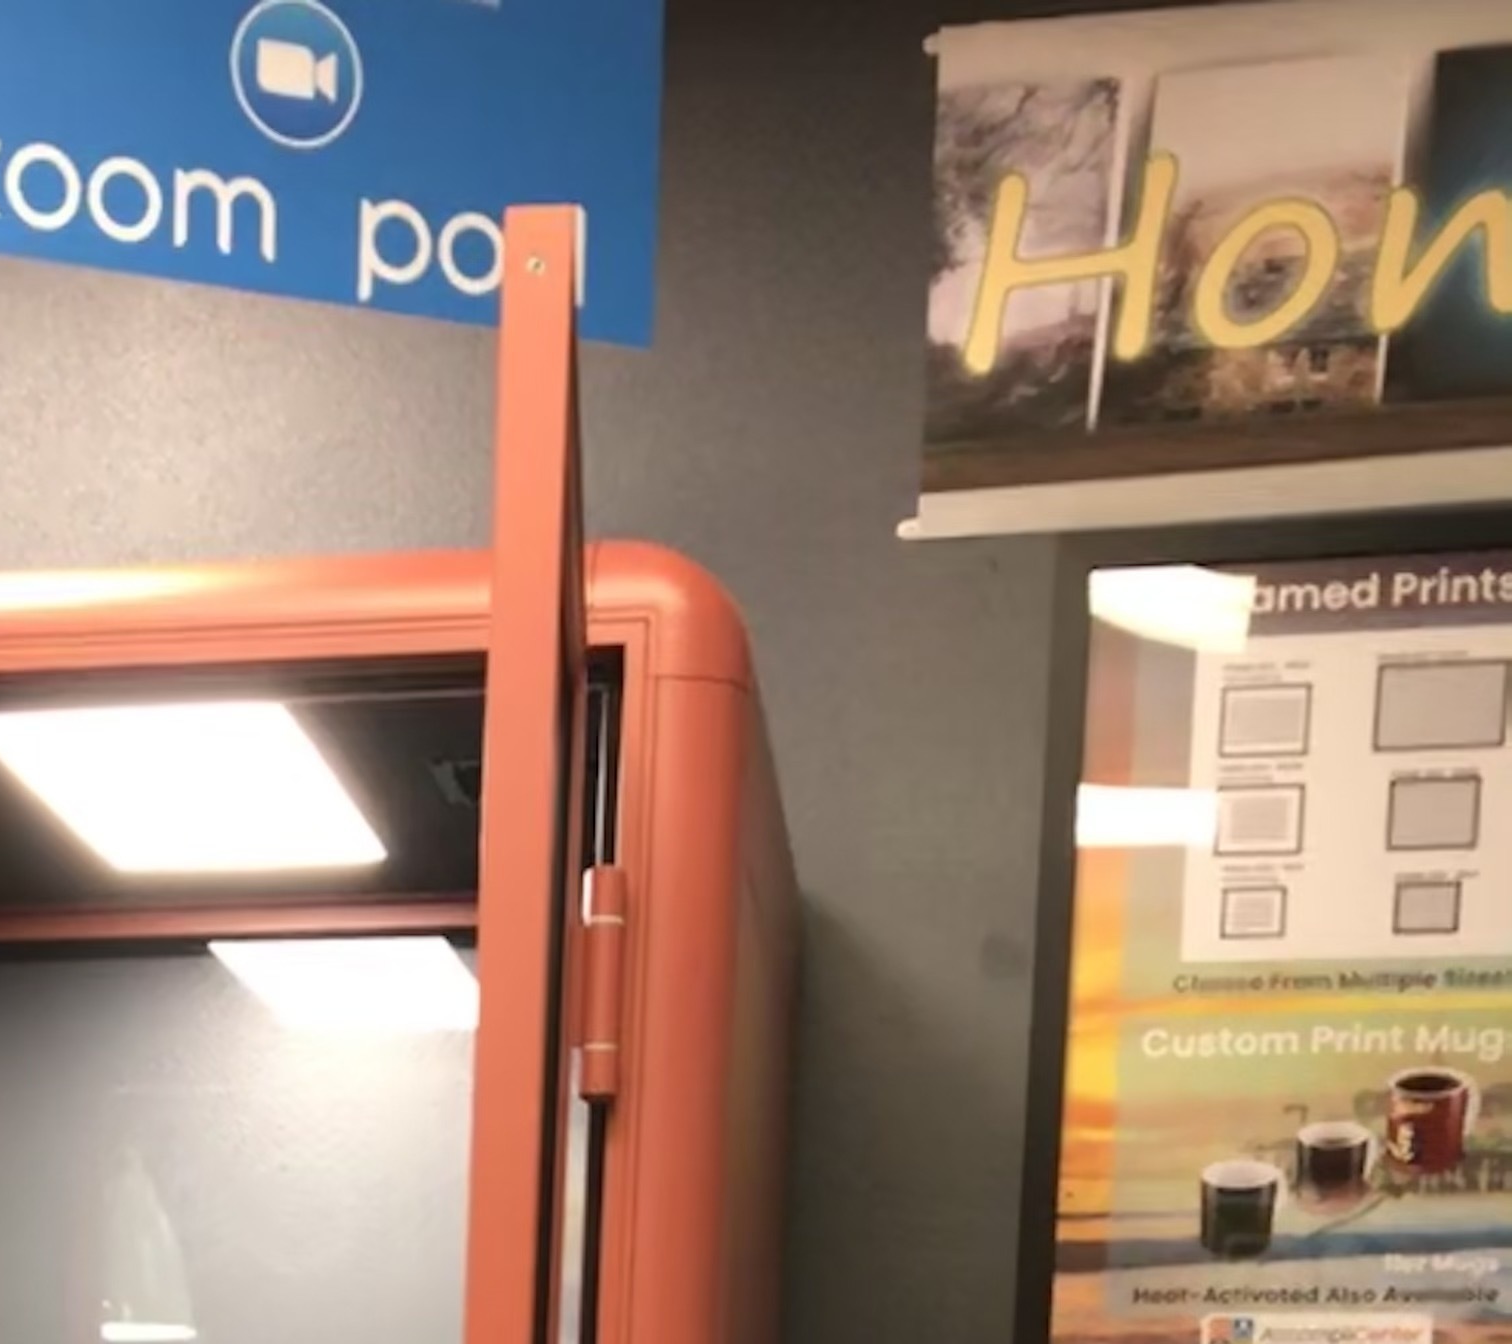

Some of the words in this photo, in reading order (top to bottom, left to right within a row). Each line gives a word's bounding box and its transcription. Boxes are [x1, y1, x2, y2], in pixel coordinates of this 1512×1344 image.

[357, 197, 587, 309] po
[1391, 565, 1512, 608] Prints
[1140, 1024, 1300, 1059] Custom
[1310, 1022, 1404, 1055] Print
[1414, 1022, 1512, 1063] Mug
